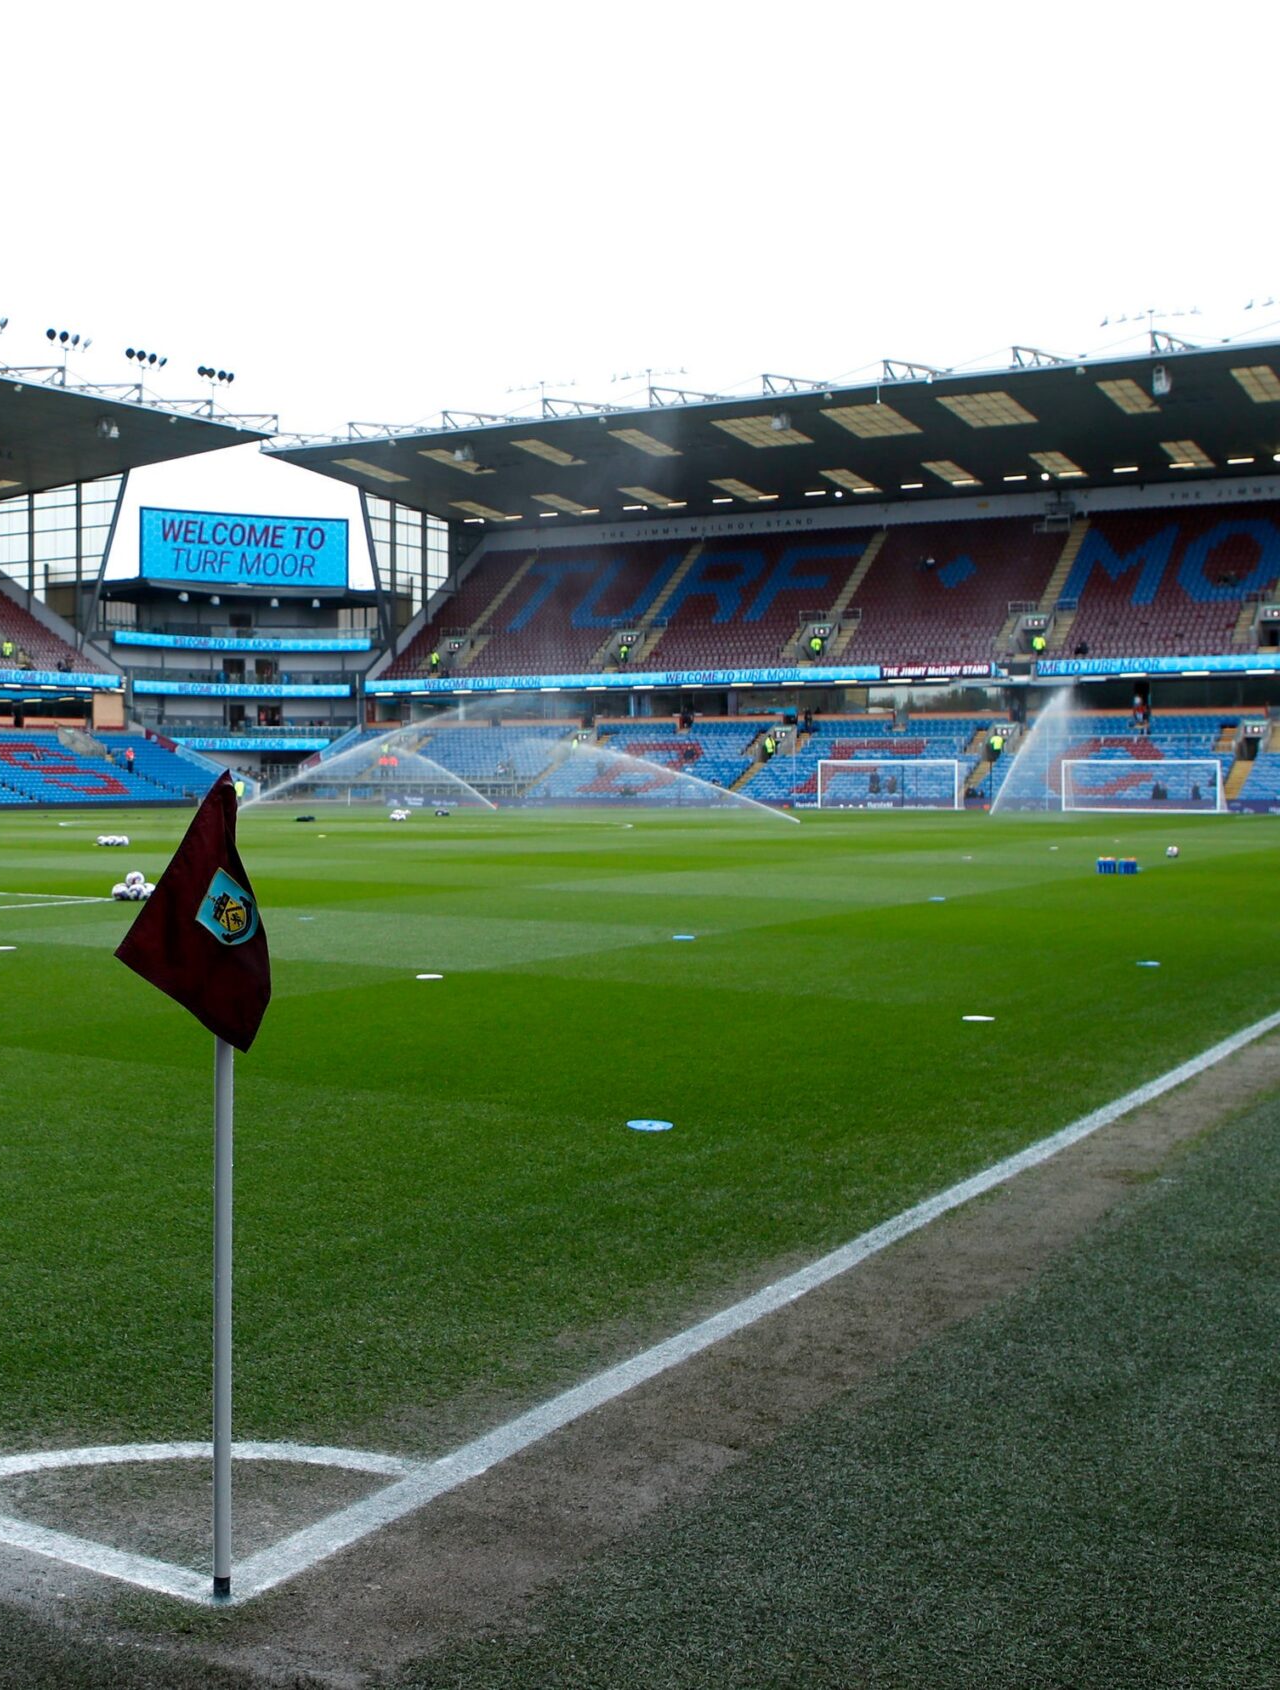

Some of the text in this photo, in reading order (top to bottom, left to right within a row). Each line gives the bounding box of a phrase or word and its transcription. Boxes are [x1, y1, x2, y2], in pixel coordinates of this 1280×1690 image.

[161, 518, 325, 550] WELCOME TO
[636, 528, 680, 537] JIMMY
[765, 517, 814, 528] STAND
[172, 547, 316, 578] TURF MOOR
[173, 637, 211, 648] WELCOME
[213, 638, 225, 649] TO
[882, 664, 990, 677] THE JIMMY McILROY STAND
[1062, 661, 1081, 673] TO
[1084, 660, 1116, 673] TURF
[1119, 659, 1160, 672] MOOR
[39, 672, 50, 682] TO
[665, 668, 802, 683] WELCOME TO TURF MOOR
[178, 684, 212, 695] WELCOME
[215, 684, 227, 695] TO
[424, 676, 541, 690] WELCOME TO TURF MOOR
